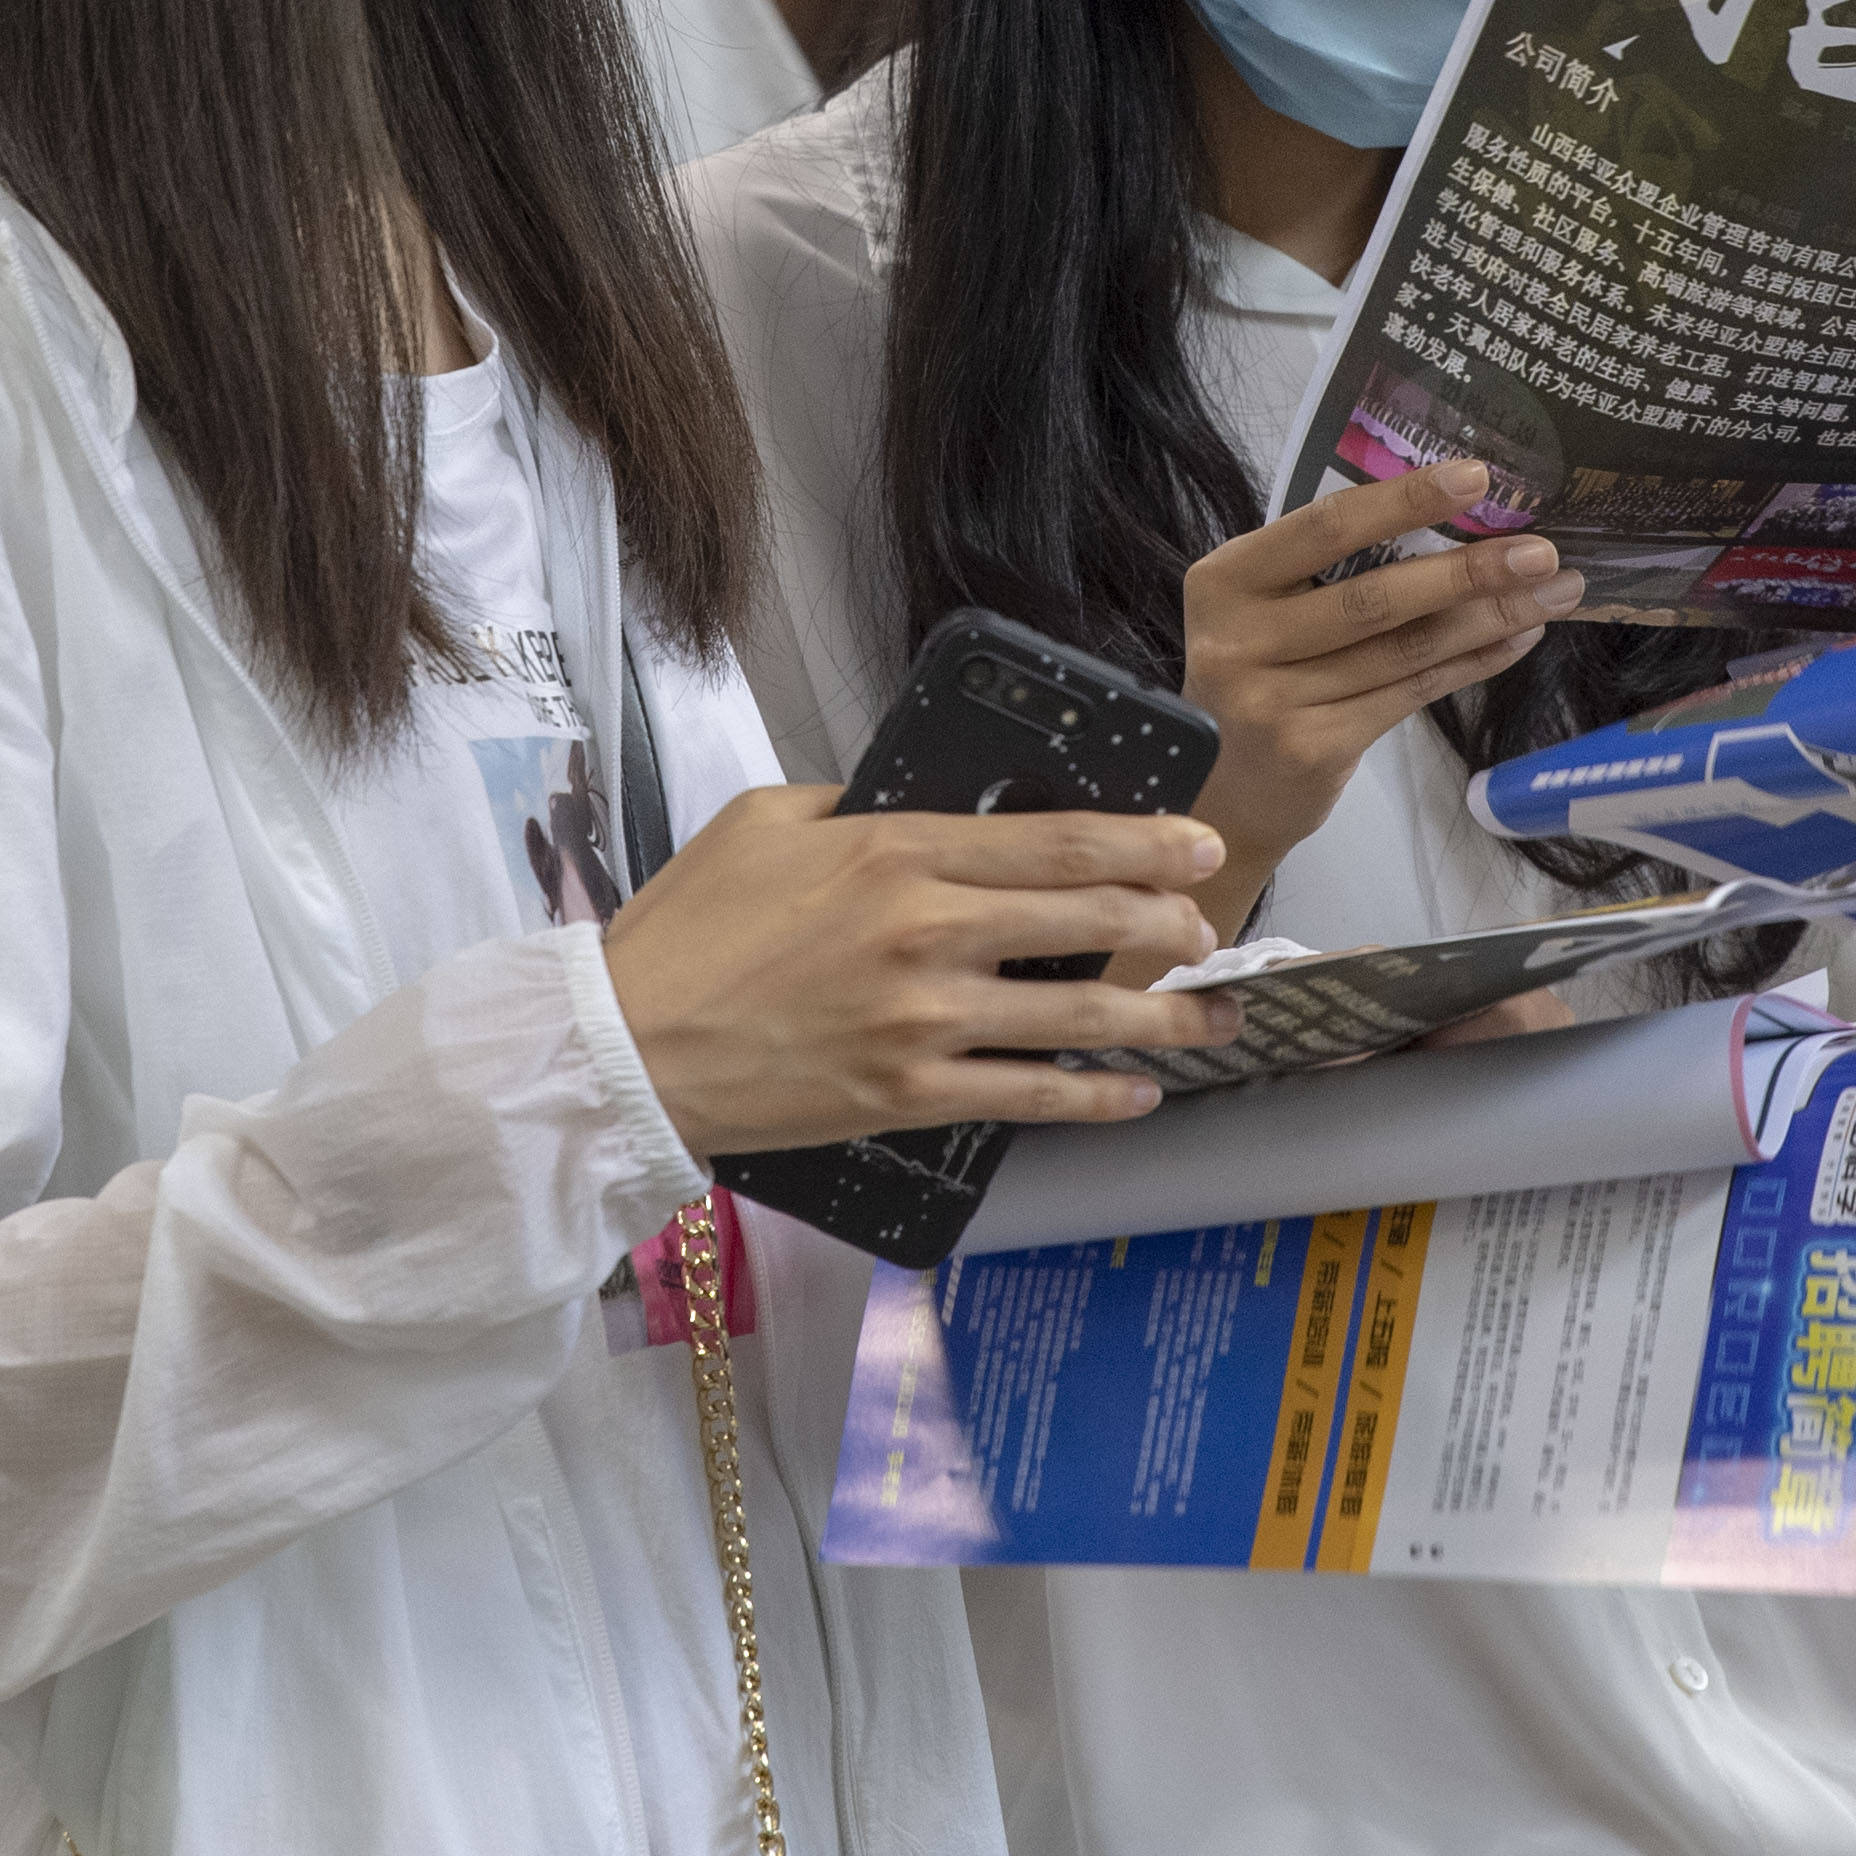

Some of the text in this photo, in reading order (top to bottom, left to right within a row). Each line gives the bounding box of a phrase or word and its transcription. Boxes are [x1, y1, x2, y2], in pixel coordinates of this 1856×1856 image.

[1504, 30, 1620, 114] 公司简介
[1381, 311, 1473, 384] 蓬勃发展。
